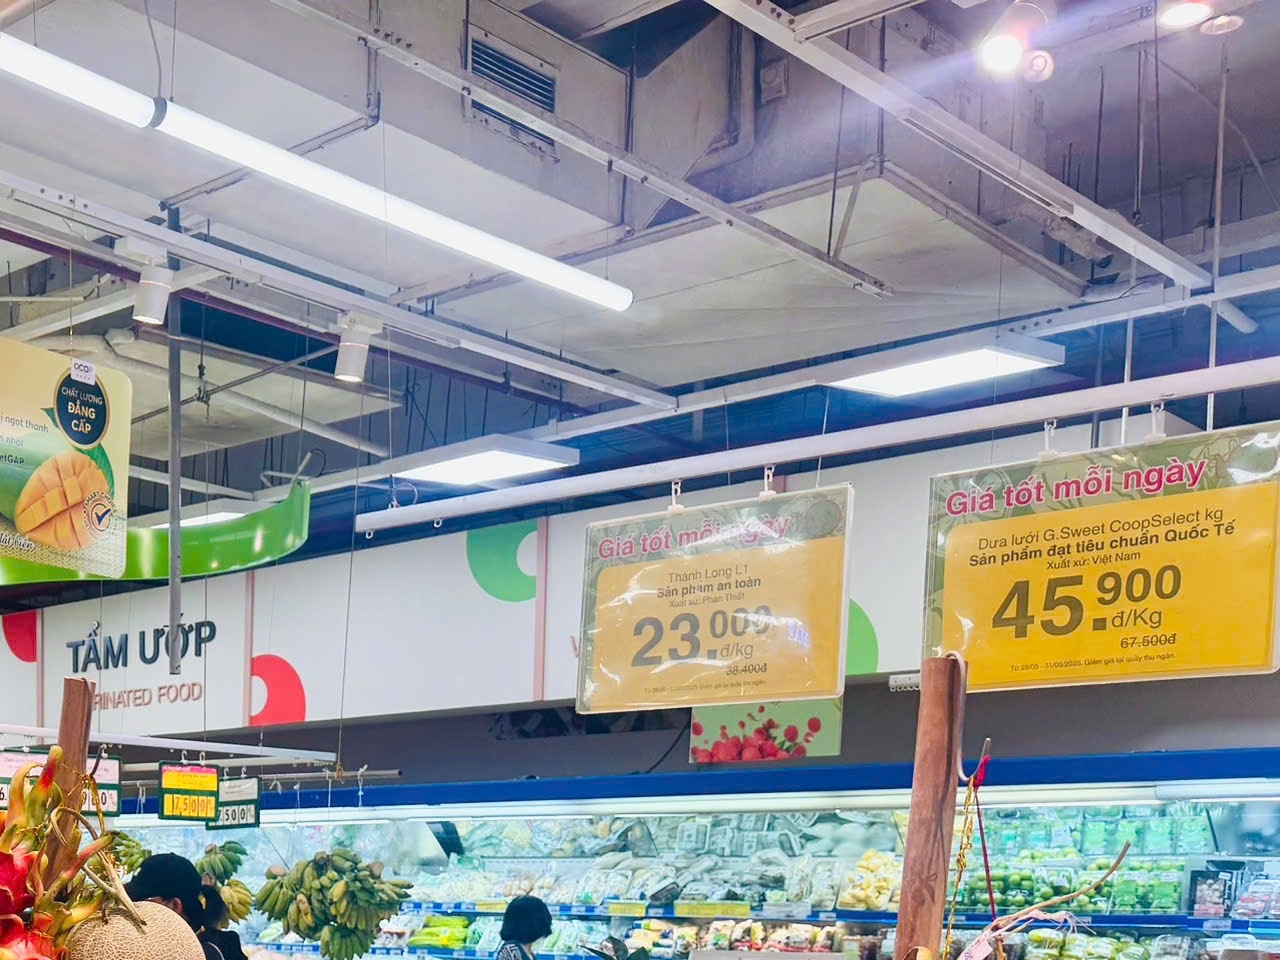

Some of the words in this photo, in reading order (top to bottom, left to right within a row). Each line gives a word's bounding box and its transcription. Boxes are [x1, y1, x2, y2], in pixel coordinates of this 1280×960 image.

[61, 386, 78, 398] CHẤT
[67, 400, 96, 420] ĐẲNG
[71, 418, 92, 434] CẤP
[946, 484, 994, 516] Giá
[1004, 476, 1044, 509] tốt
[1054, 464, 1112, 499] mỗi
[1123, 458, 1207, 495] ngày
[978, 537, 1007, 551] Dưa
[1011, 529, 1039, 546] lưới
[1043, 523, 1105, 542] G.Sweet
[1113, 509, 1200, 533] CoopSelect
[1205, 506, 1224, 523] kg
[598, 535, 634, 560] Giá
[641, 528, 671, 553] tốt
[969, 551, 997, 568] Sản
[1001, 543, 1042, 565] phẩm
[1047, 540, 1071, 558] đạt
[1076, 536, 1105, 553] tiêu
[1109, 529, 1159, 549] chuẩn
[1164, 523, 1209, 542] Quốc
[1213, 518, 1236, 536] Tế
[1115, 550, 1142, 562] Nam
[668, 570, 702, 583] Thanh
[705, 567, 732, 580] Long
[735, 563, 749, 575] L1
[657, 584, 679, 599] Sản
[716, 581, 732, 591] an
[735, 576, 761, 589] toàn
[66, 620, 128, 673] TẨM
[93, 688, 152, 710] RINATED
[158, 682, 203, 704] FOOD
